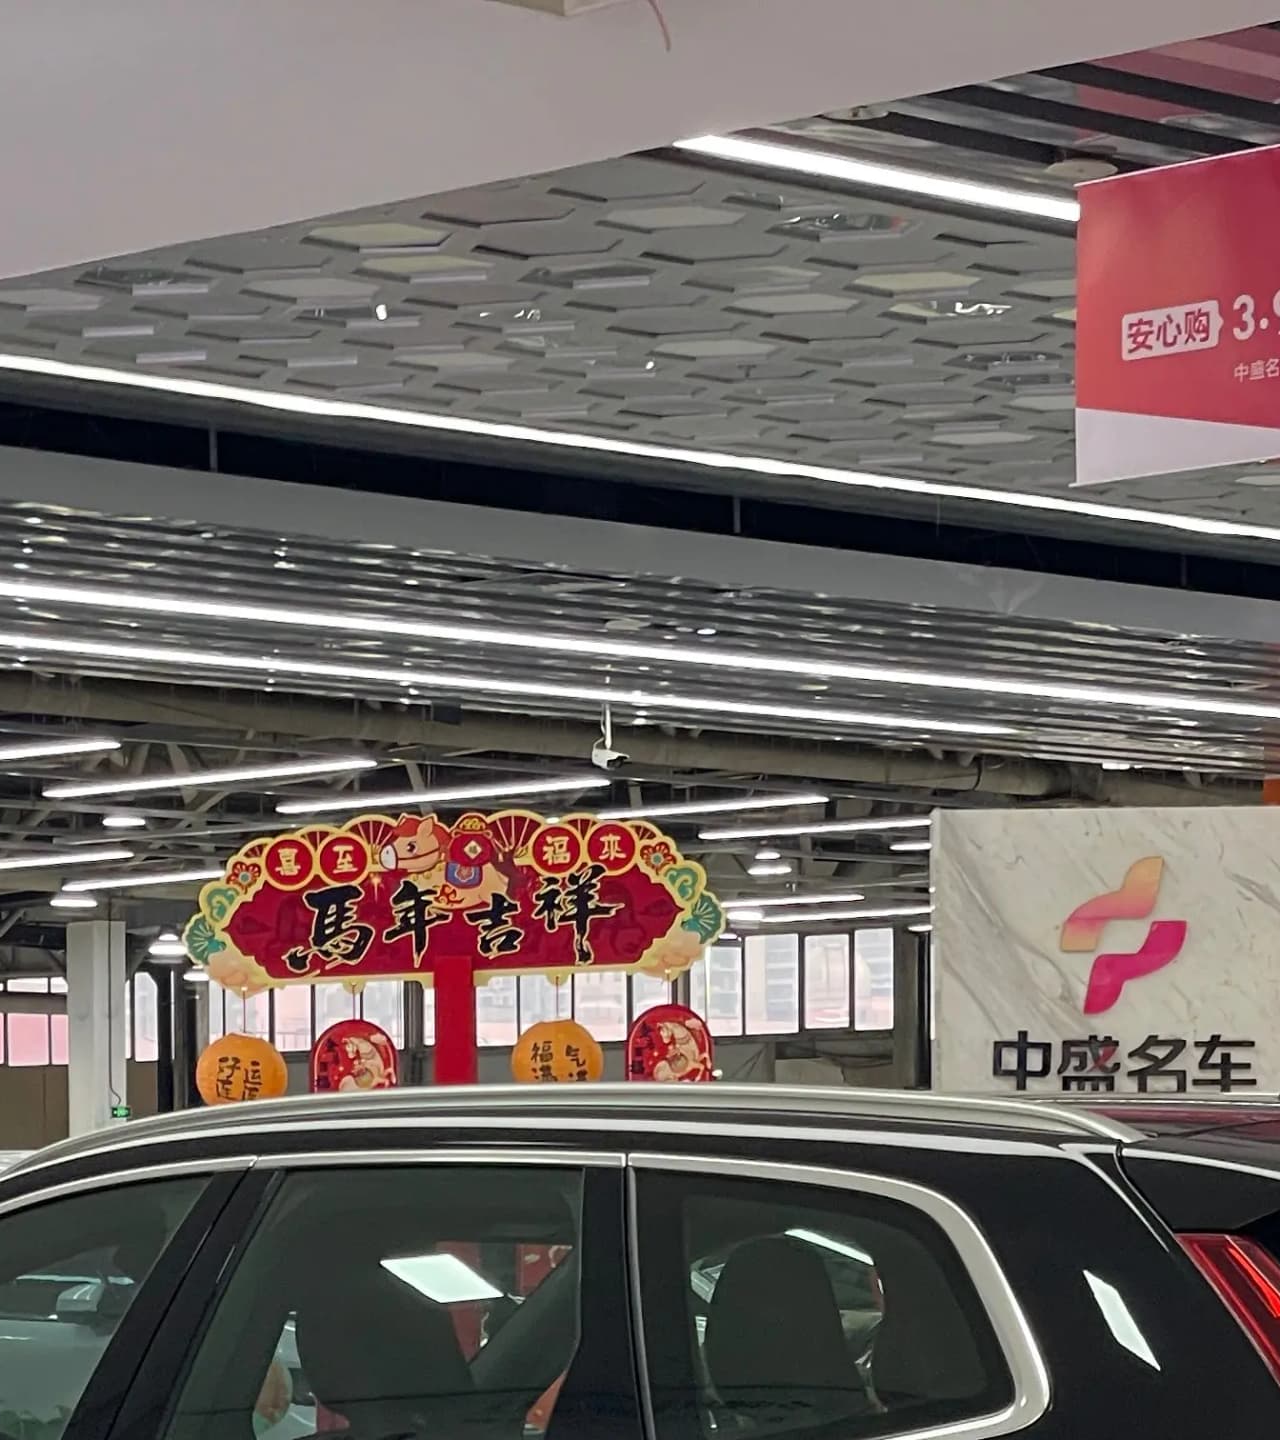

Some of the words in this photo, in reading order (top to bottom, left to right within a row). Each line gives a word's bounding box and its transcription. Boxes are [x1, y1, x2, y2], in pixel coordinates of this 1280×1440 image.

[1127, 310, 1209, 353] 安心购
[993, 1031, 1257, 1092] 中盛名车
